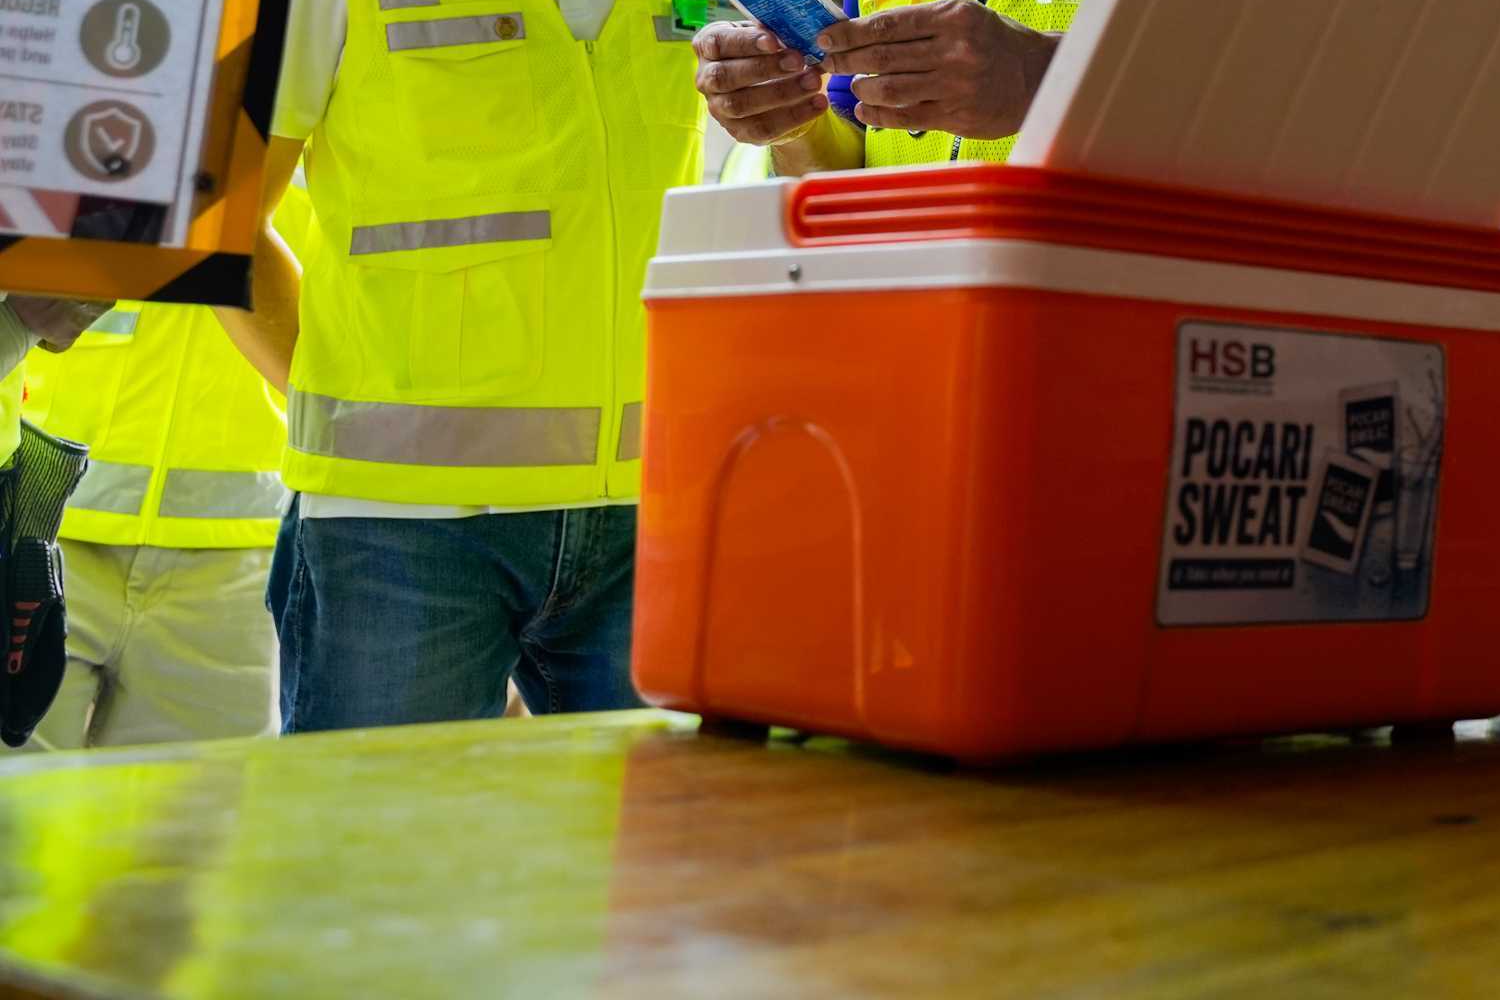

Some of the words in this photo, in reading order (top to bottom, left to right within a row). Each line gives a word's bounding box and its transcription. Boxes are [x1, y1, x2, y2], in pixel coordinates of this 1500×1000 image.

[1189, 338, 1276, 379] HSB
[1181, 417, 1315, 482] POCARI
[1173, 482, 1308, 547] SWEAT
